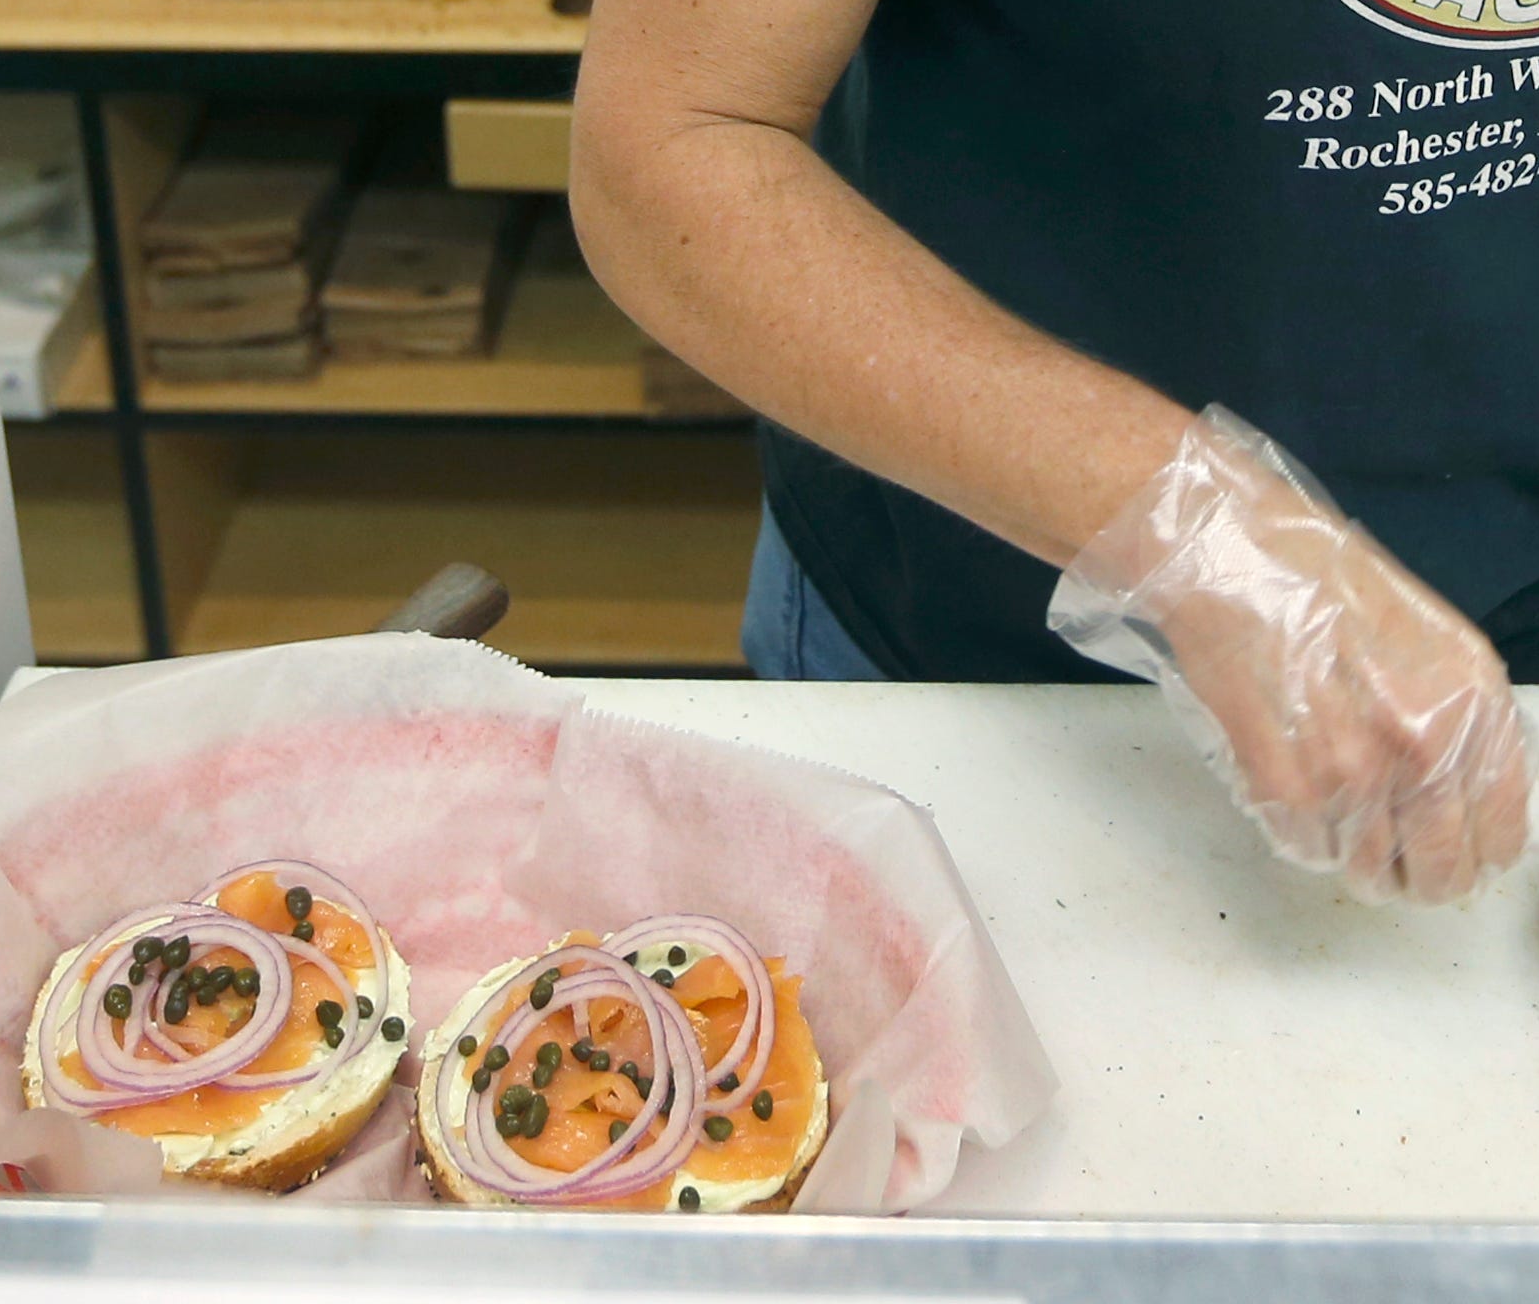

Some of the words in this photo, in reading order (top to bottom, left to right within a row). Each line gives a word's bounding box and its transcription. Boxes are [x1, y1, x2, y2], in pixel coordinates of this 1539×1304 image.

[1263, 84, 1356, 124] 288
[1368, 63, 1494, 118] North
[1298, 119, 1525, 170] Rochester,
